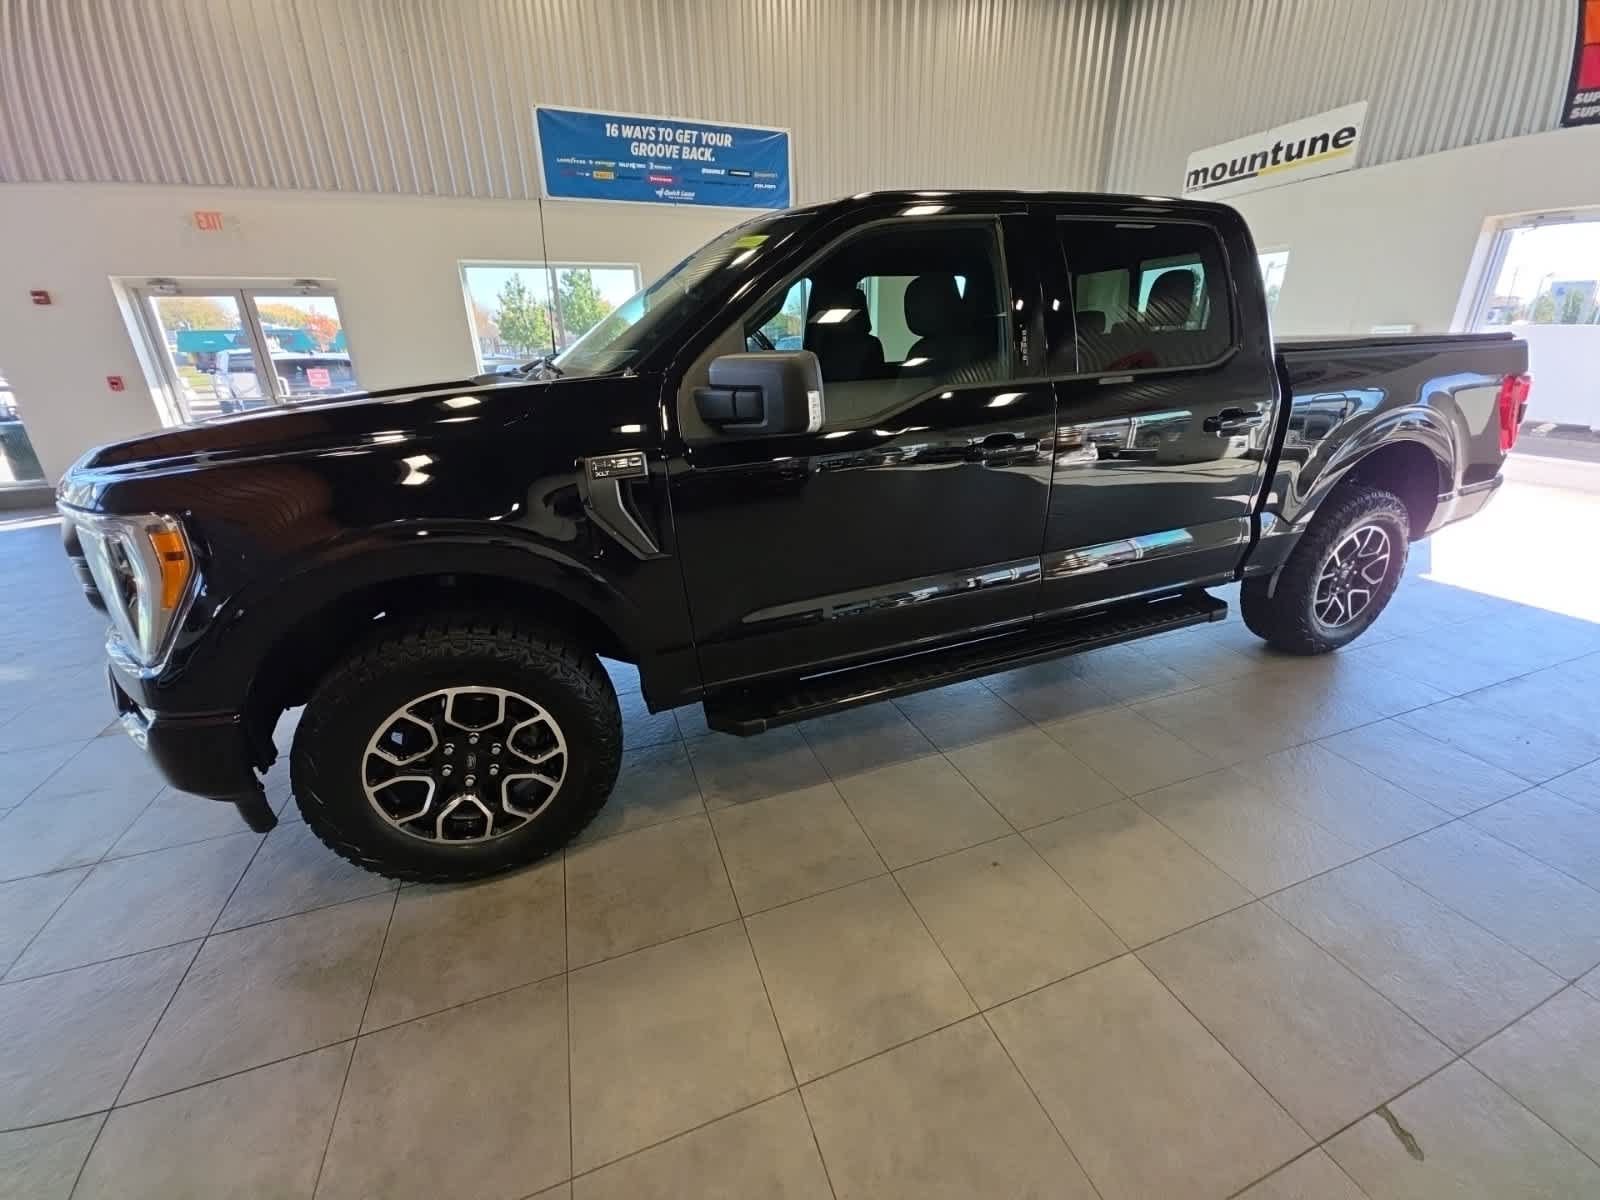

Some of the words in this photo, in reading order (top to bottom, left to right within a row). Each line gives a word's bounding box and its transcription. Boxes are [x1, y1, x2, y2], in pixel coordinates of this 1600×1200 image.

[605, 123, 619, 137] 16
[621, 124, 655, 140] WAYS
[657, 127, 673, 141] TO
[675, 129, 698, 144] GET
[700, 131, 732, 147] YOUR
[630, 142, 680, 159] GROOVE
[682, 146, 716, 162] BACK.
[1186, 126, 1356, 188] mountune
[194, 211, 224, 231] EXIT
[595, 470, 609, 478] XLT
